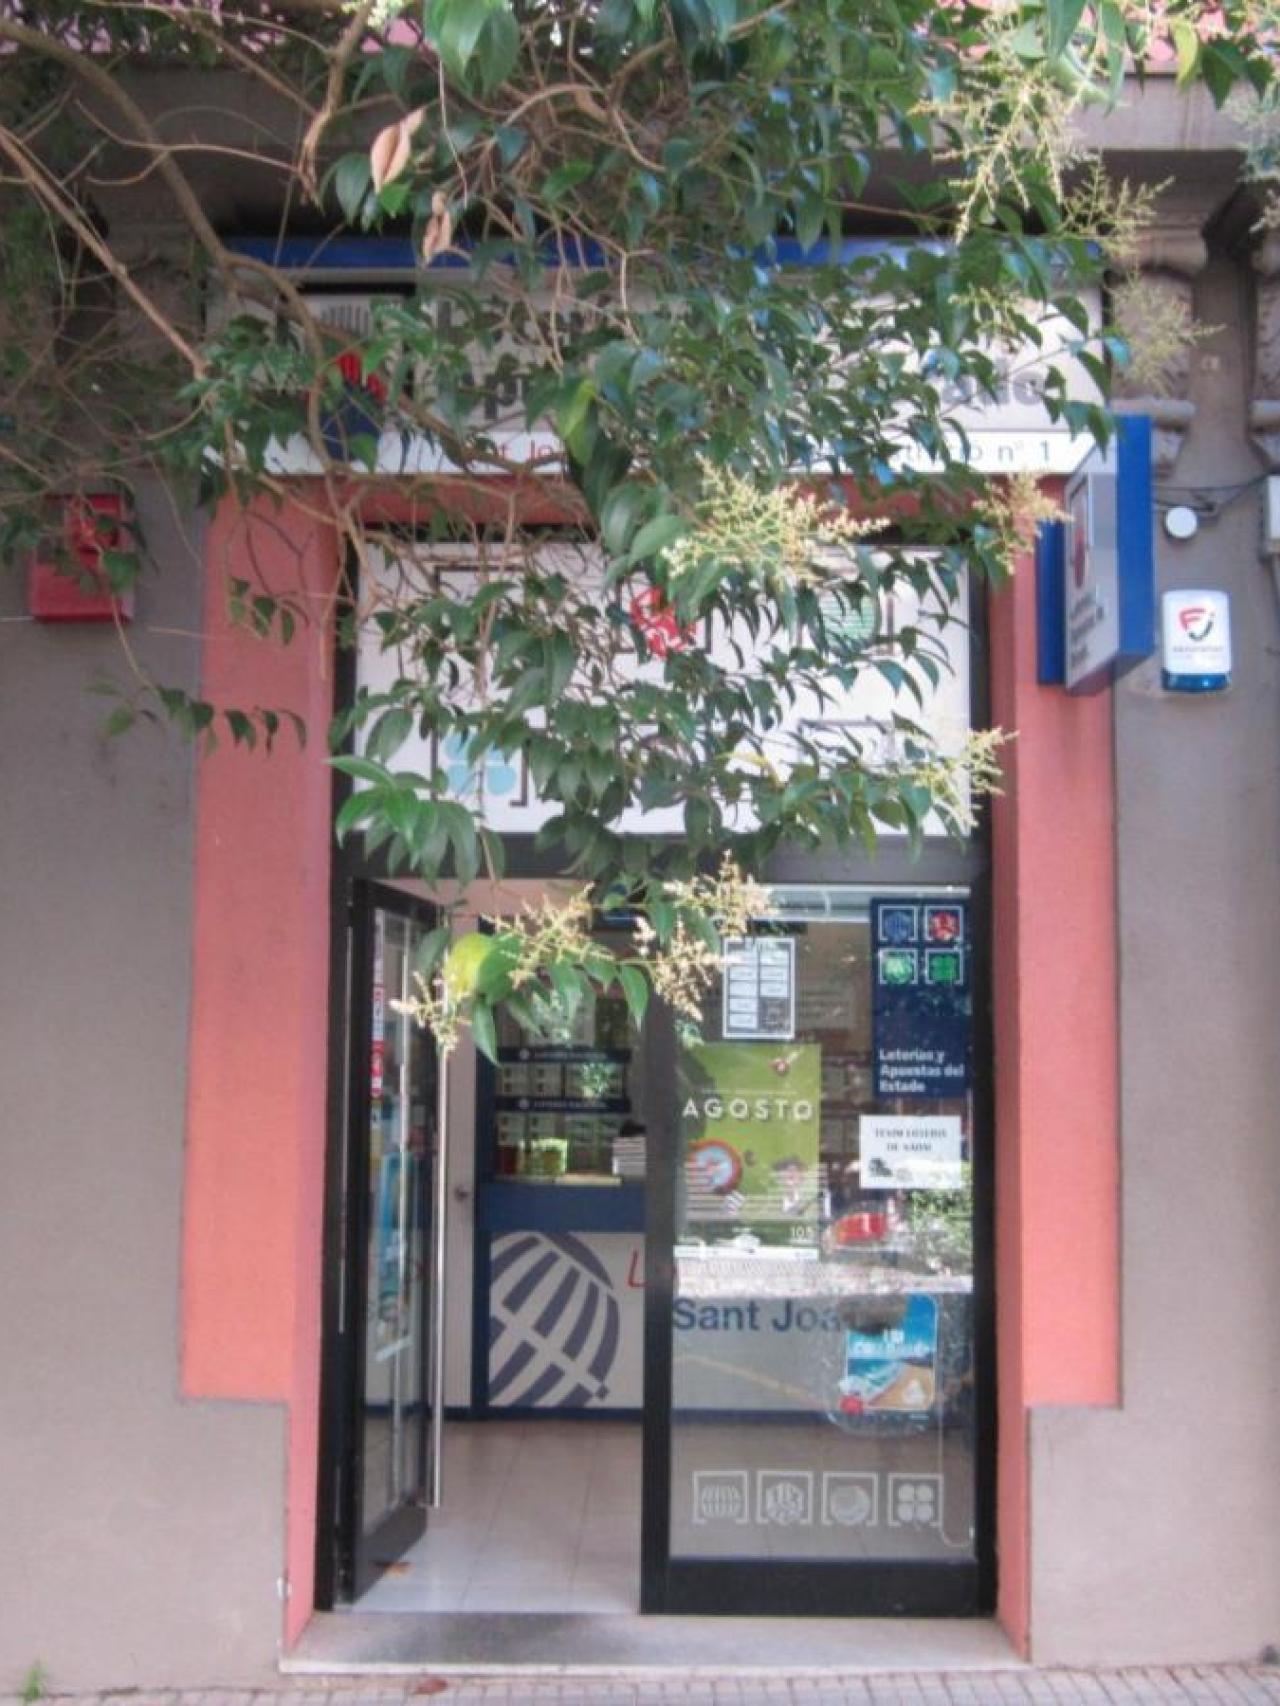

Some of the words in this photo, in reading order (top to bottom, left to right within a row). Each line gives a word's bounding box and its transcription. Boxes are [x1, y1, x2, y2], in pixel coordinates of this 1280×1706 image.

[1040, 438, 1051, 462] 1
[879, 1080, 925, 1093] Estado
[682, 1097, 813, 1121] AGOSTO
[673, 1298, 761, 1332] Sant
[772, 1298, 842, 1332] Joa
